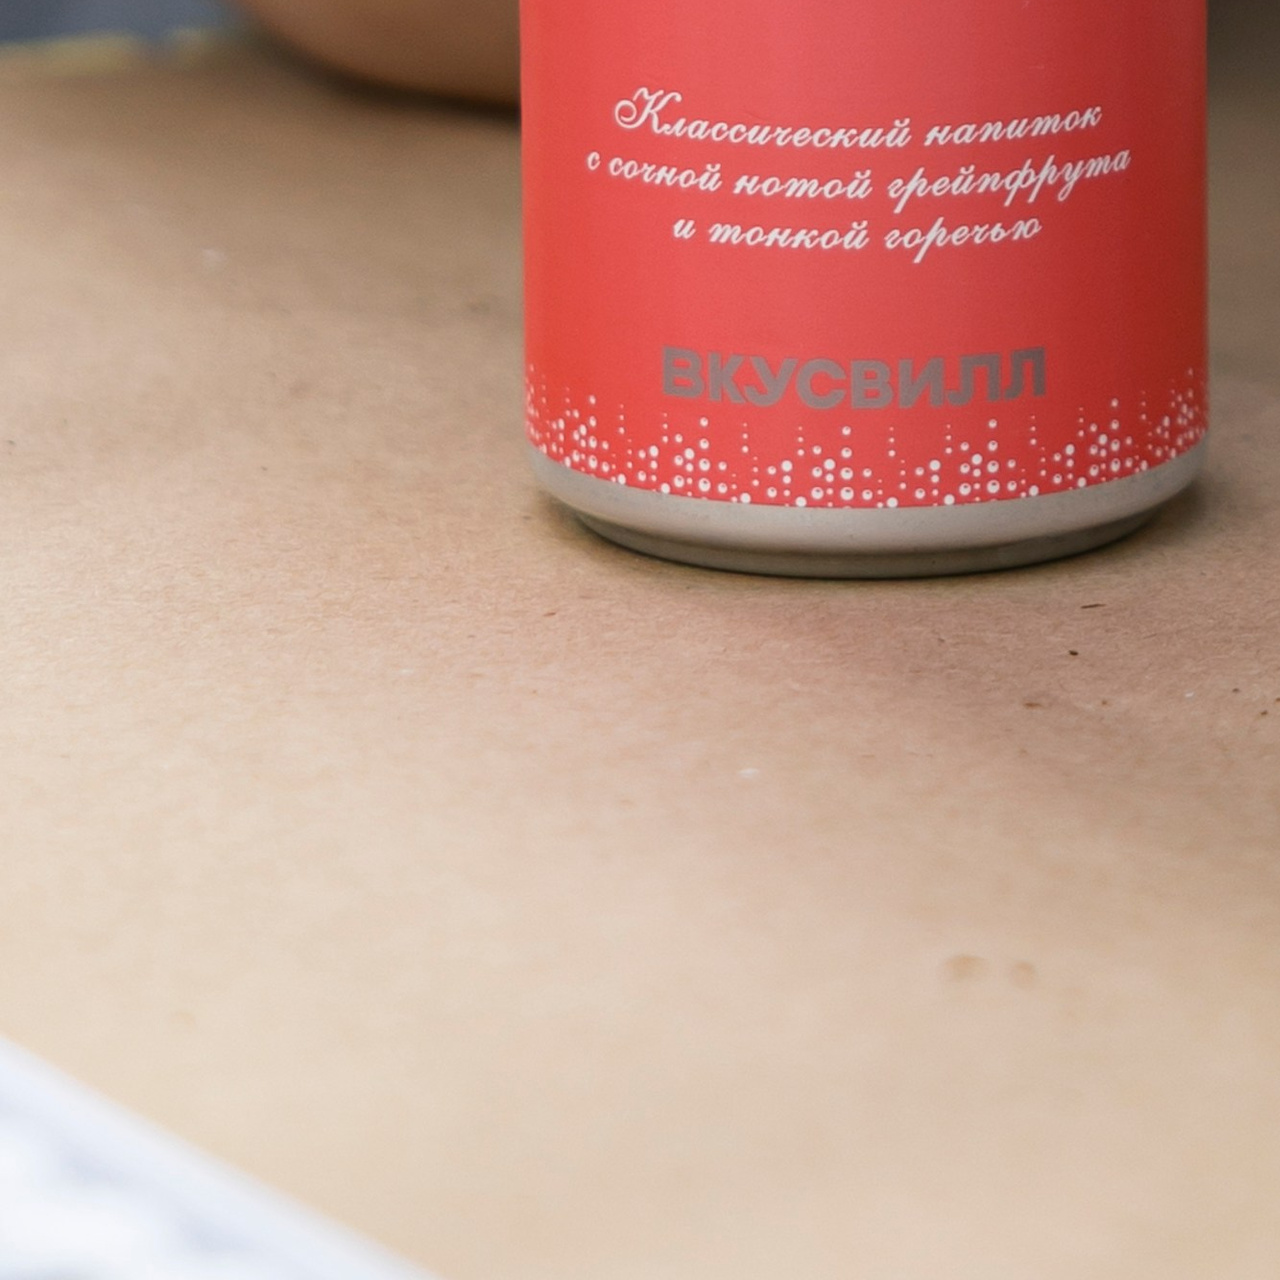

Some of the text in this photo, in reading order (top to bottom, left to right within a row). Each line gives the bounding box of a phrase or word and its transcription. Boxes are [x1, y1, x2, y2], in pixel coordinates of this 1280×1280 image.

[613, 86, 1103, 150] Классический напиток
[586, 148, 1132, 214] с сочной нотой грейпфрута
[672, 213, 1043, 264] и тонкой горечью
[660, 345, 1047, 410] ВКУСВИЛЛ
